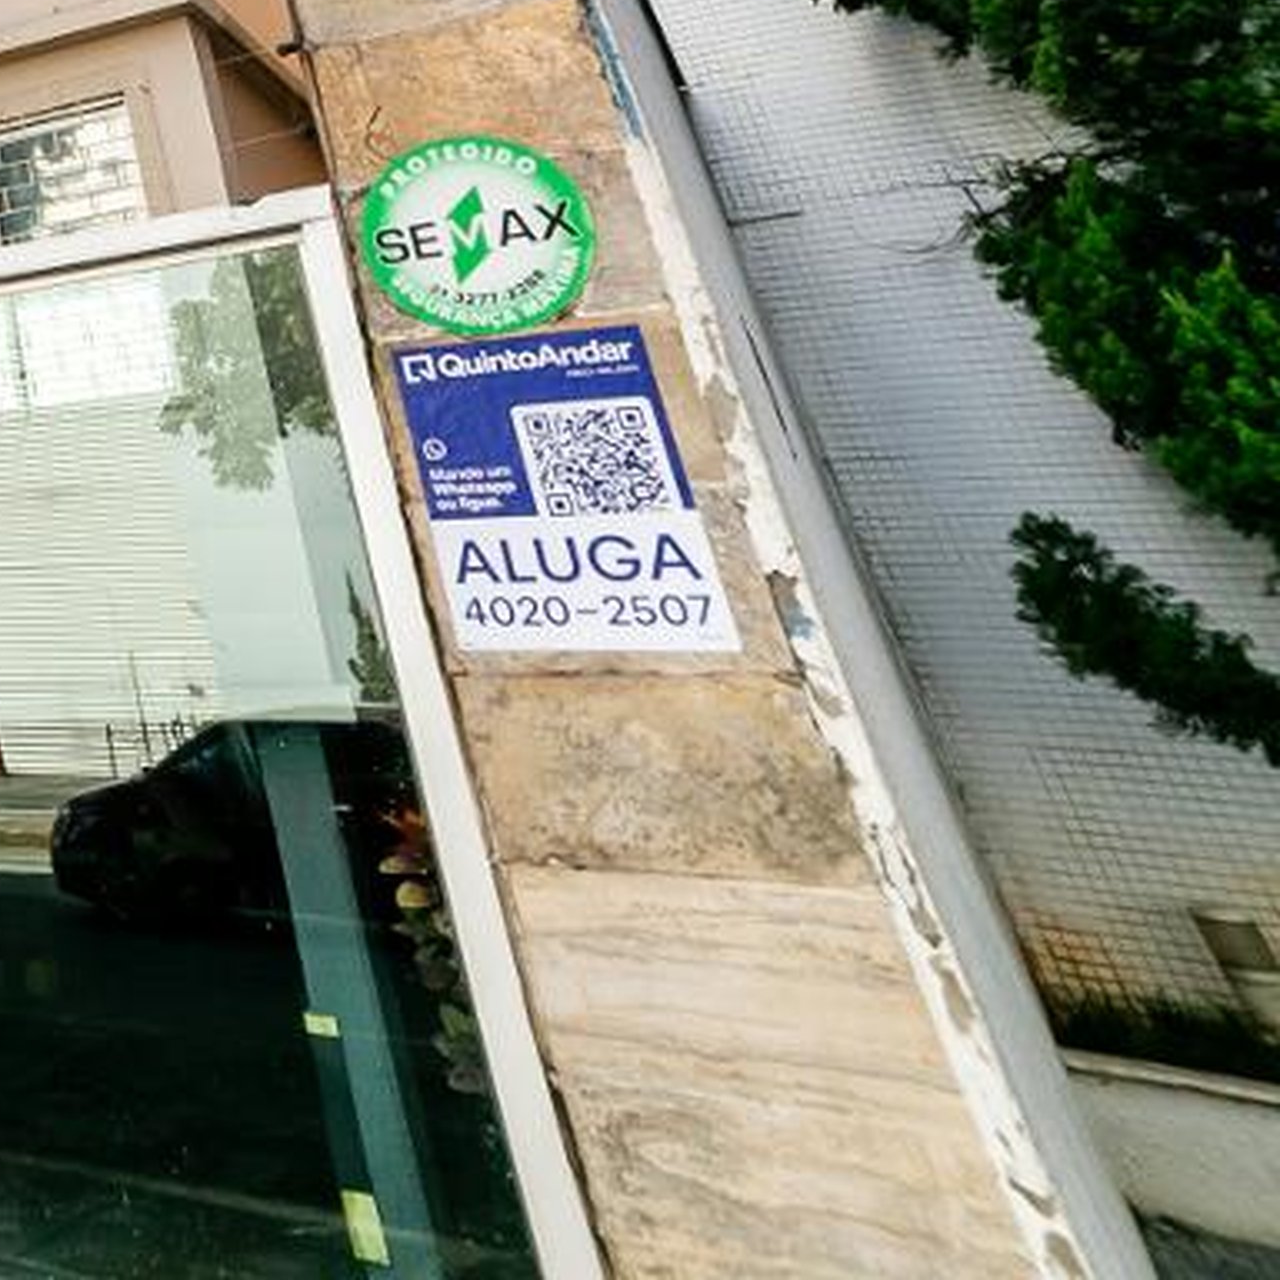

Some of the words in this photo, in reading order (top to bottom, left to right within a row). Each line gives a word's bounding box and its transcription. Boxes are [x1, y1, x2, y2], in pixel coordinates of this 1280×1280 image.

[437, 339, 634, 379] QuintoAndar
[456, 533, 703, 584] ALUGA
[465, 594, 711, 627] 4020-2507
